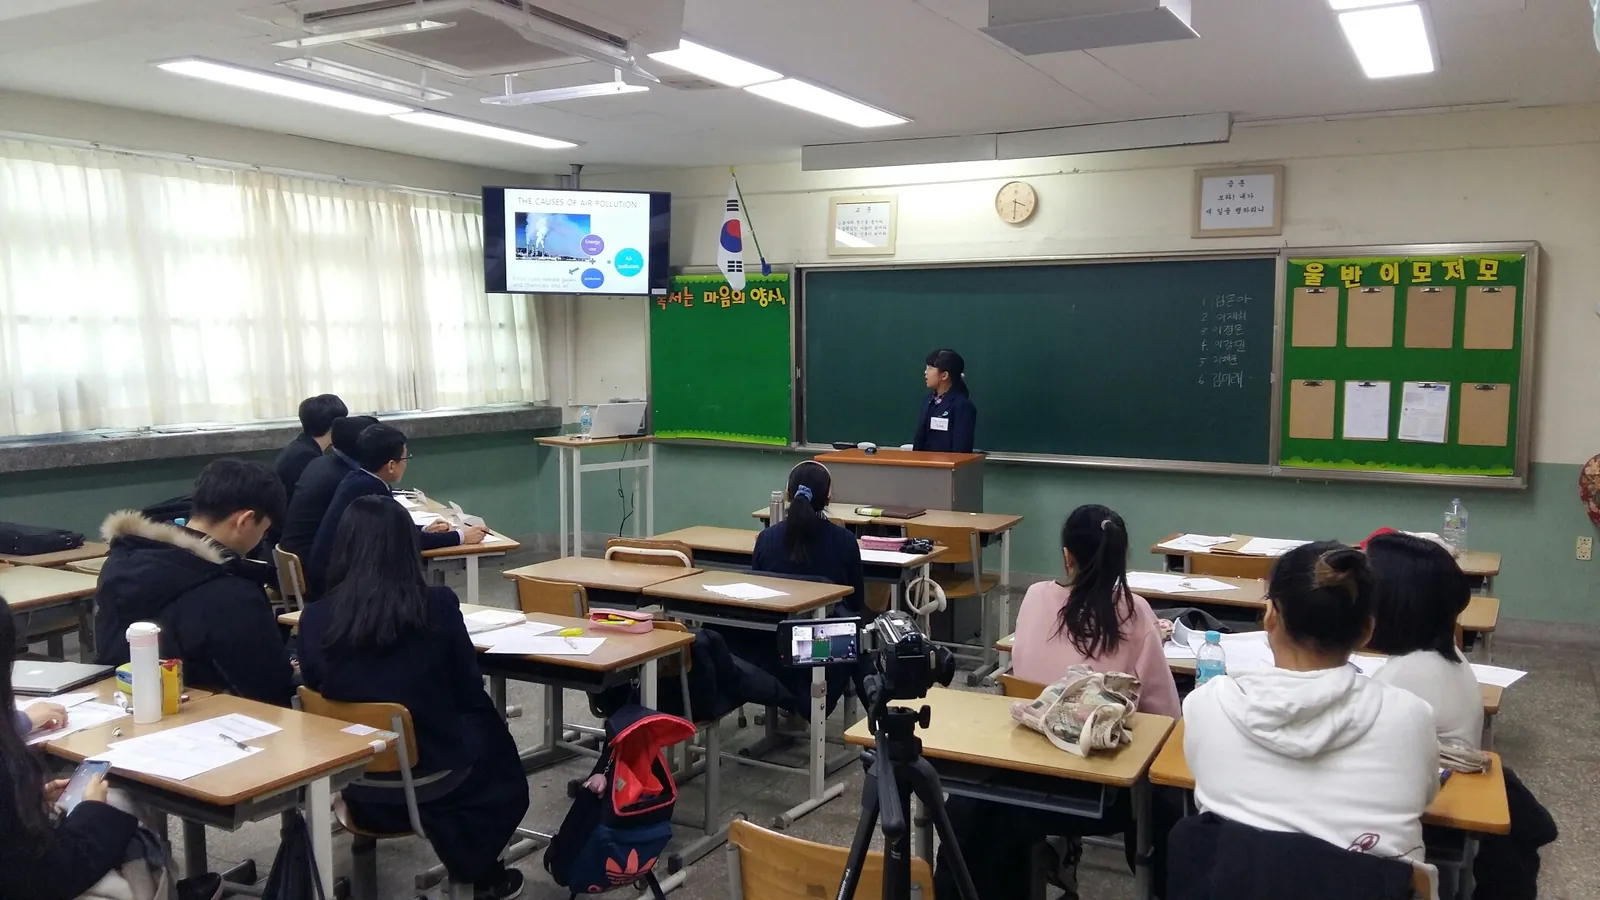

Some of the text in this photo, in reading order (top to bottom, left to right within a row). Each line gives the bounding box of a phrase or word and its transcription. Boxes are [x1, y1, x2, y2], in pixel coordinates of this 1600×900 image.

[1218, 193, 1235, 201] 보라!
[518, 197, 638, 208] THE CAUSES OF AIR POLLUTION
[1216, 207, 1231, 215] 일을
[1235, 206, 1265, 214] 행하리니
[704, 285, 745, 308] 마음의
[750, 287, 786, 308] 양식
[1200, 312, 1208, 322] 2
[1201, 327, 1208, 335] 3
[1199, 357, 1207, 367] 5
[1198, 371, 1243, 388] 6 김미래
